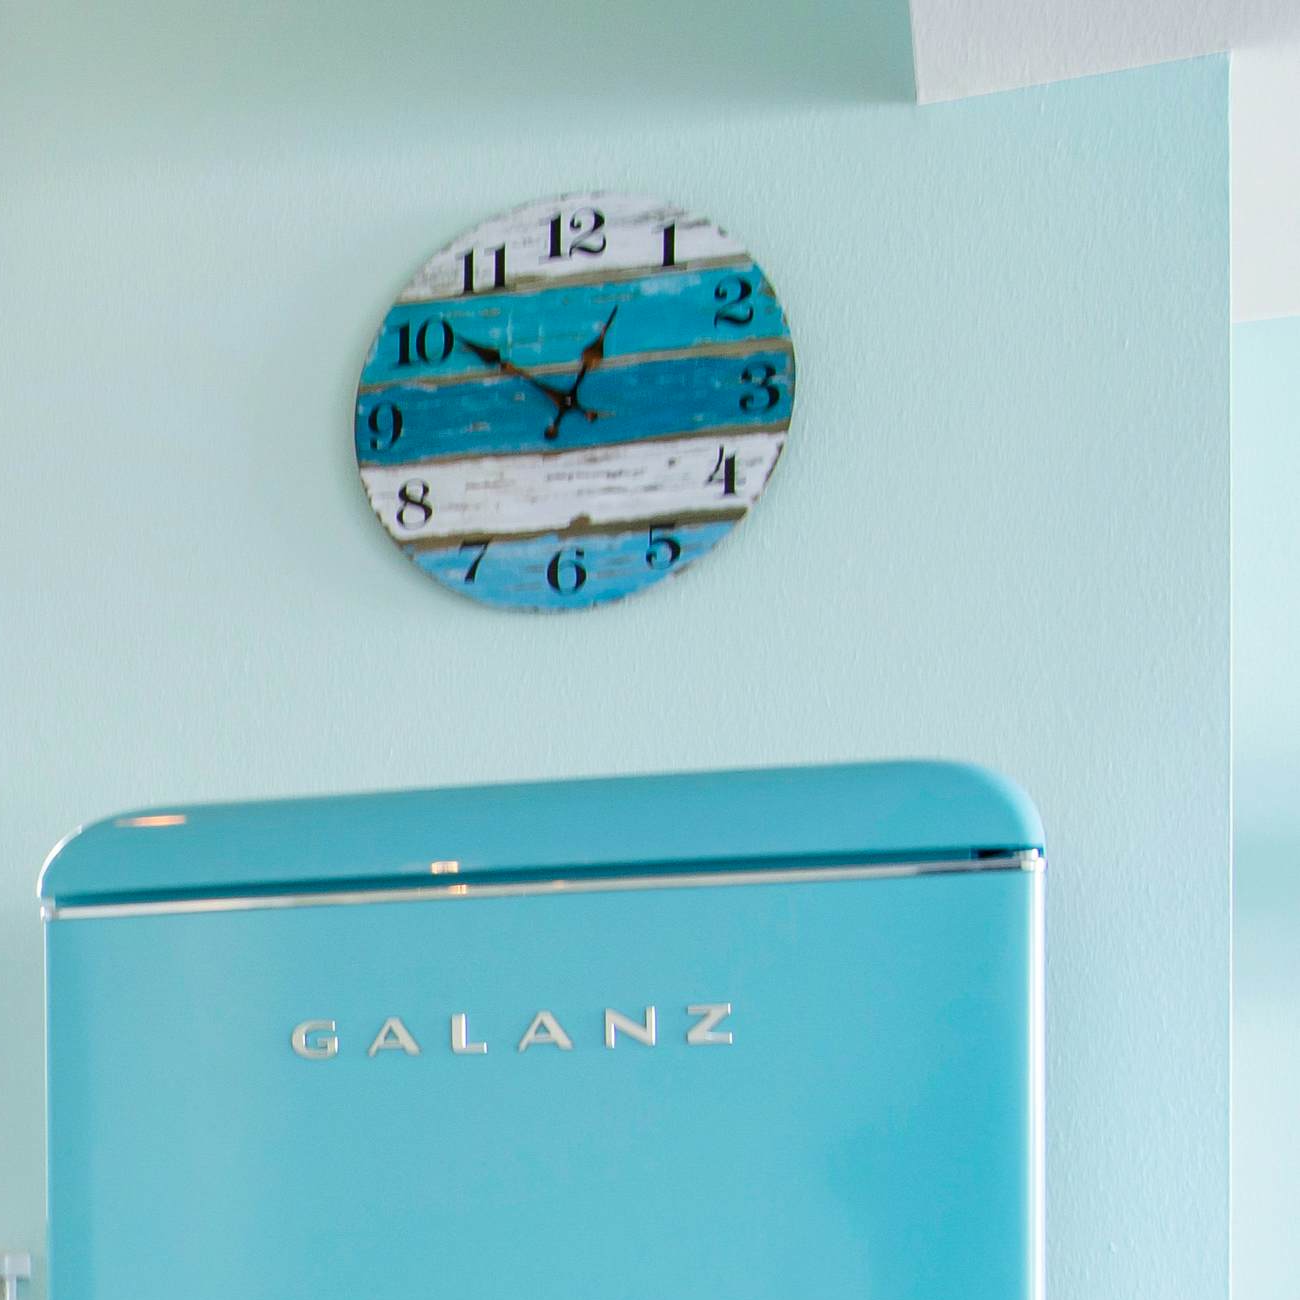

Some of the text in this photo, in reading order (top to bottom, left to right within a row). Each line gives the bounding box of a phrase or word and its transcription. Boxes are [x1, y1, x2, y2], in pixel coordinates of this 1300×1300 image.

[542, 208, 607, 260] 12
[656, 221, 680, 266] 1
[458, 242, 508, 294] 11
[713, 275, 754, 328] 2
[394, 318, 455, 368] 10
[739, 361, 780, 414] 3
[367, 403, 403, 451] 9
[705, 446, 745, 497] 4
[396, 478, 433, 531] 8
[460, 540, 491, 584] 7
[547, 548, 587, 595] 6
[645, 523, 681, 570] 5
[291, 1002, 733, 1060] GALANZ
